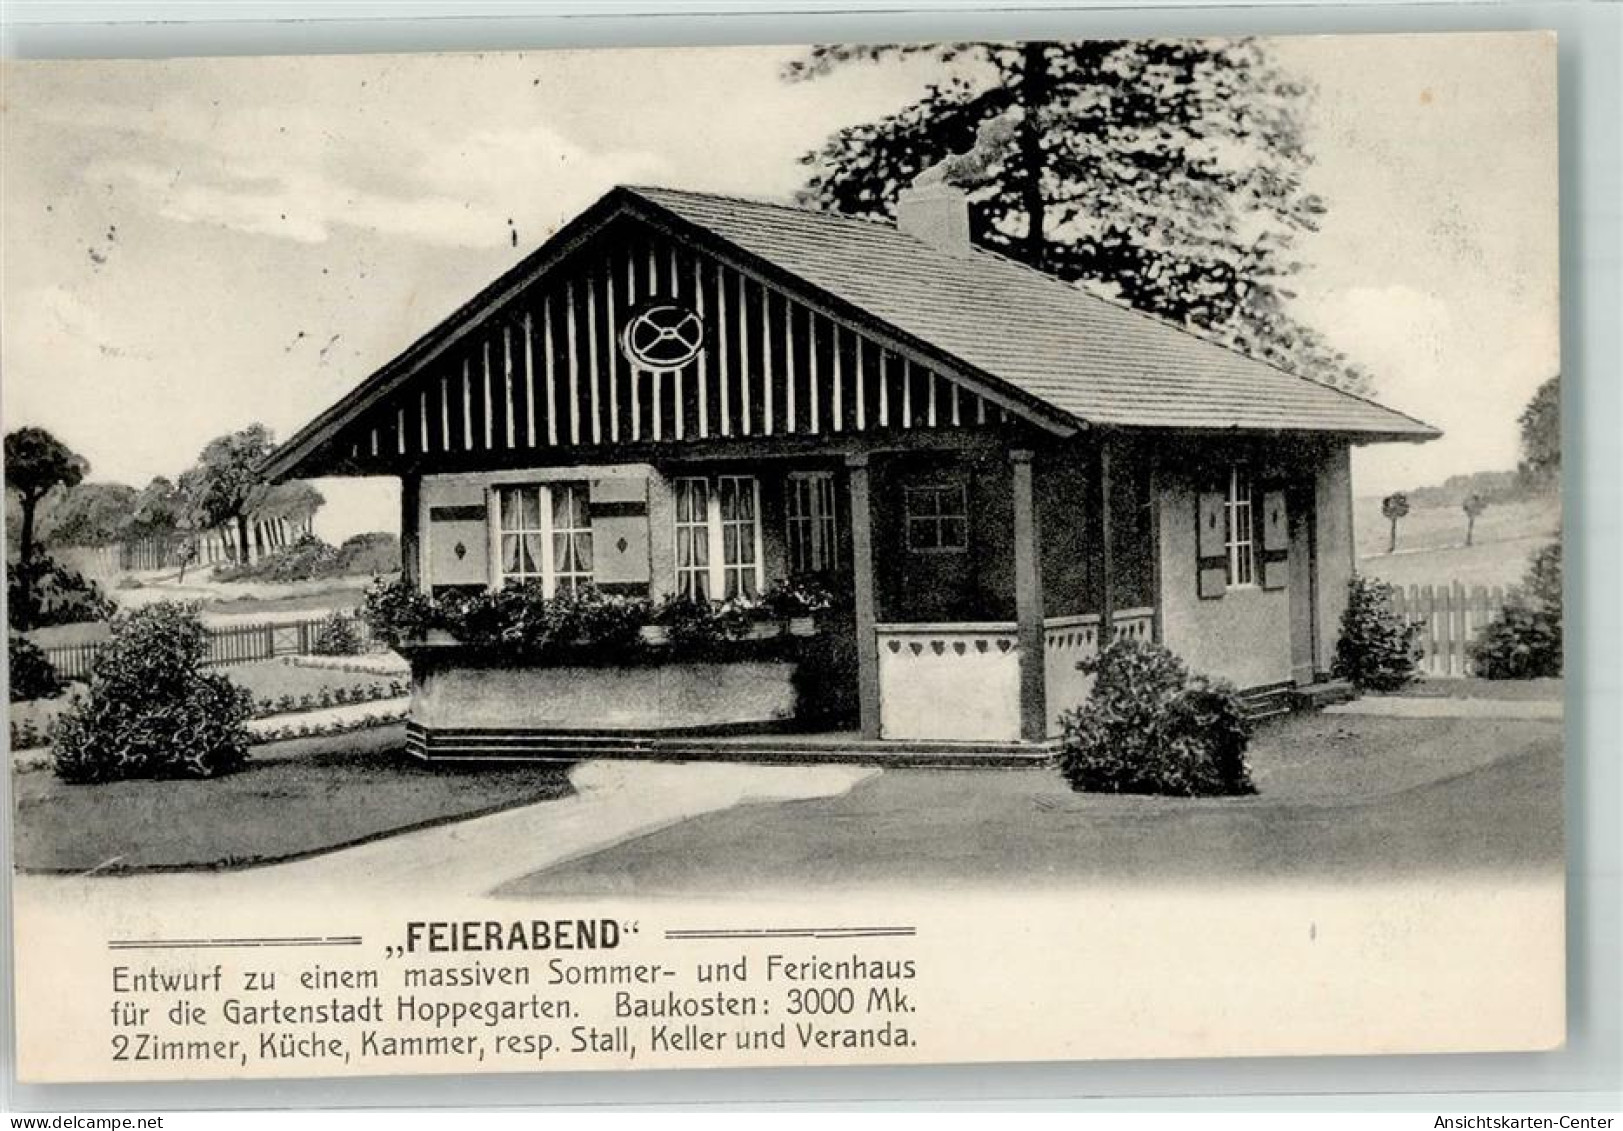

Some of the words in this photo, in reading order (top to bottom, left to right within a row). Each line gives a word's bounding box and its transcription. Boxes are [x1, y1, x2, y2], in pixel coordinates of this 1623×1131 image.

[113, 964, 222, 992] Entwurf
[244, 973, 274, 991] zu
[300, 964, 378, 989] einem
[404, 960, 529, 987] massiven
[548, 958, 676, 985] Sommer-
[698, 955, 747, 982] und
[768, 954, 916, 982] Ferienhaus
[111, 1001, 149, 1027] für
[168, 999, 206, 1025] die
[223, 996, 383, 1025] Gartenstadt
[397, 994, 582, 1030] Hoppegarten.
[616, 991, 768, 1018] Baukosten:
[787, 987, 855, 1015] 3000
[867, 987, 916, 1013] Mk.
[260, 1032, 349, 1063] Küche,
[362, 1030, 484, 1062] Kammer,
[496, 1034, 560, 1060] resp.
[571, 1025, 636, 1059] Stall,
[651, 1025, 727, 1051] Keller
[736, 1023, 785, 1050] und
[796, 1021, 916, 1048] Veranda.
